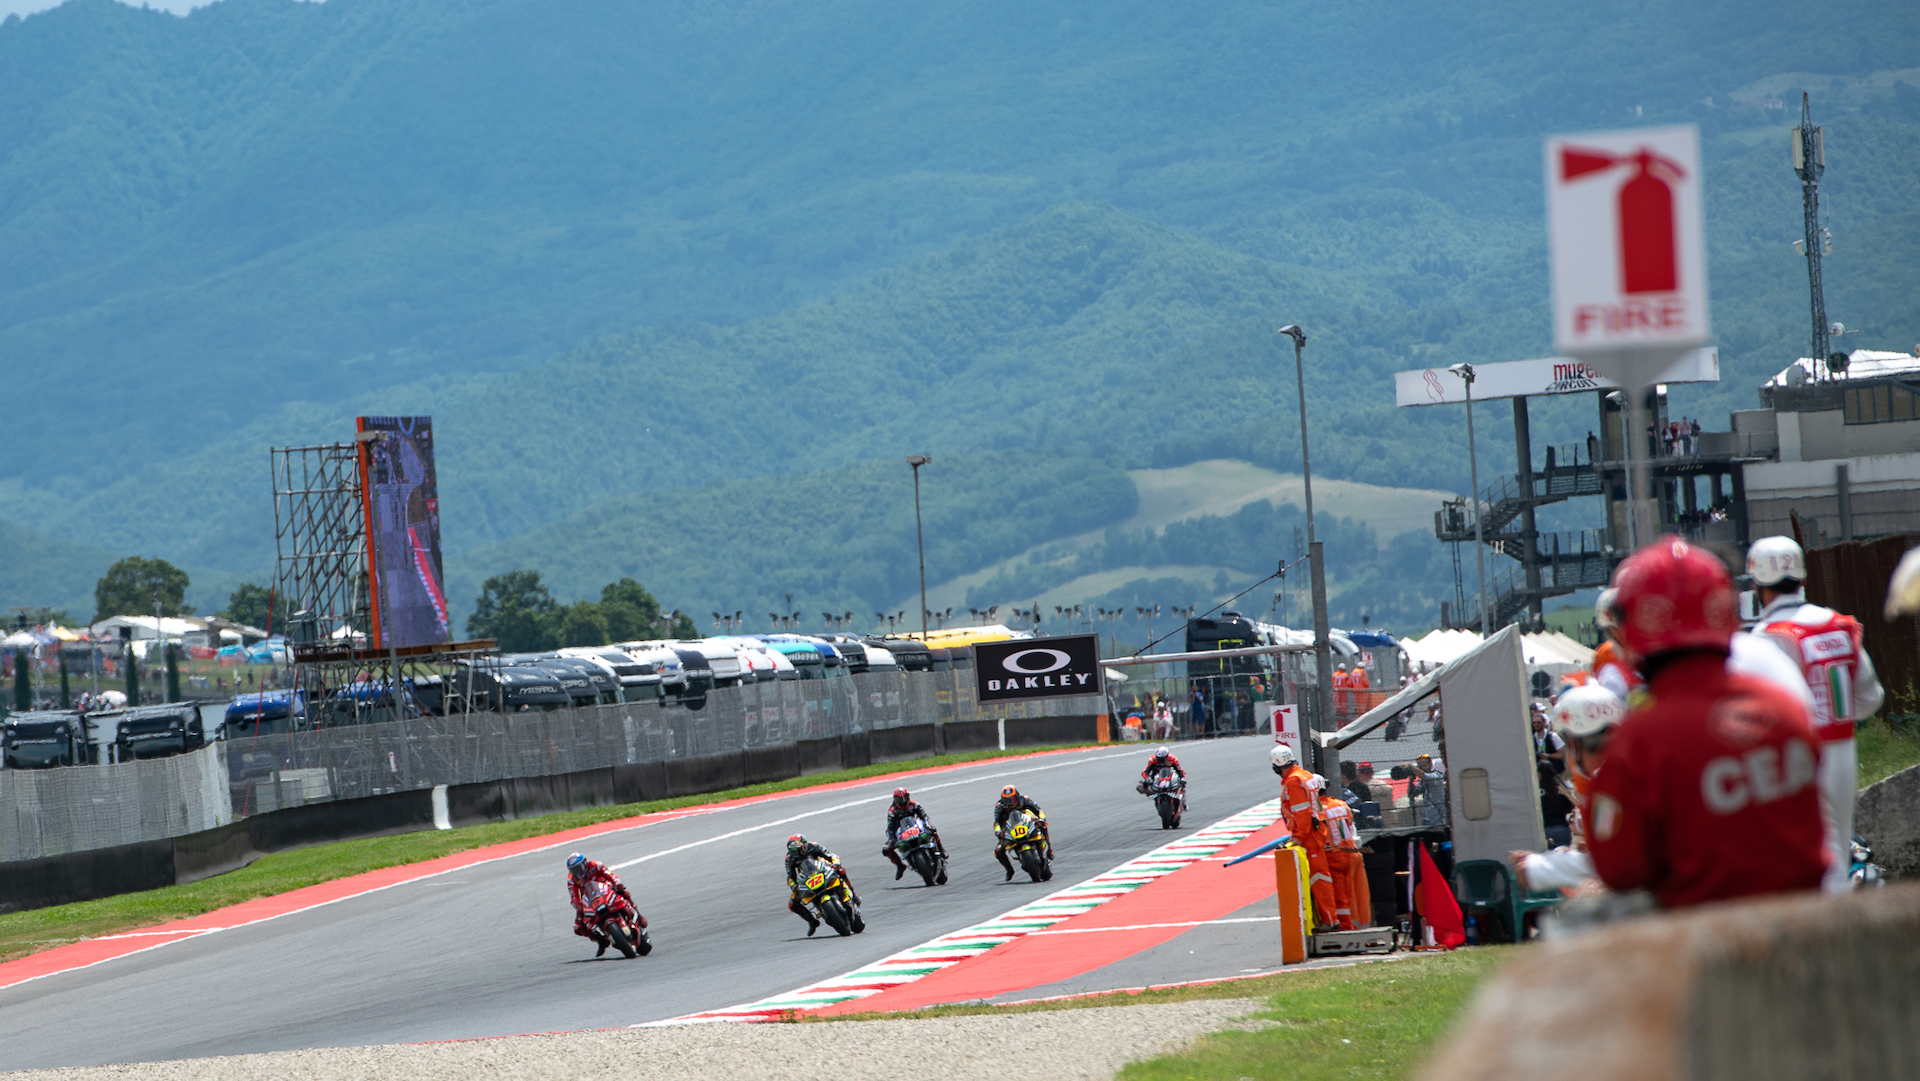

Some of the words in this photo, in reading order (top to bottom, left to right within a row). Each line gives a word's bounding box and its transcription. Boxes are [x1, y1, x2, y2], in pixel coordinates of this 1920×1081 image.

[1573, 303, 1686, 334] FIRE
[1545, 378, 1598, 391] CIRCUIT
[988, 673, 1089, 691] OAKLEY
[1275, 731, 1298, 739] FIRE
[1700, 737, 1816, 815] CEA
[1014, 827, 1026, 837] 10
[807, 875, 822, 888] 72
